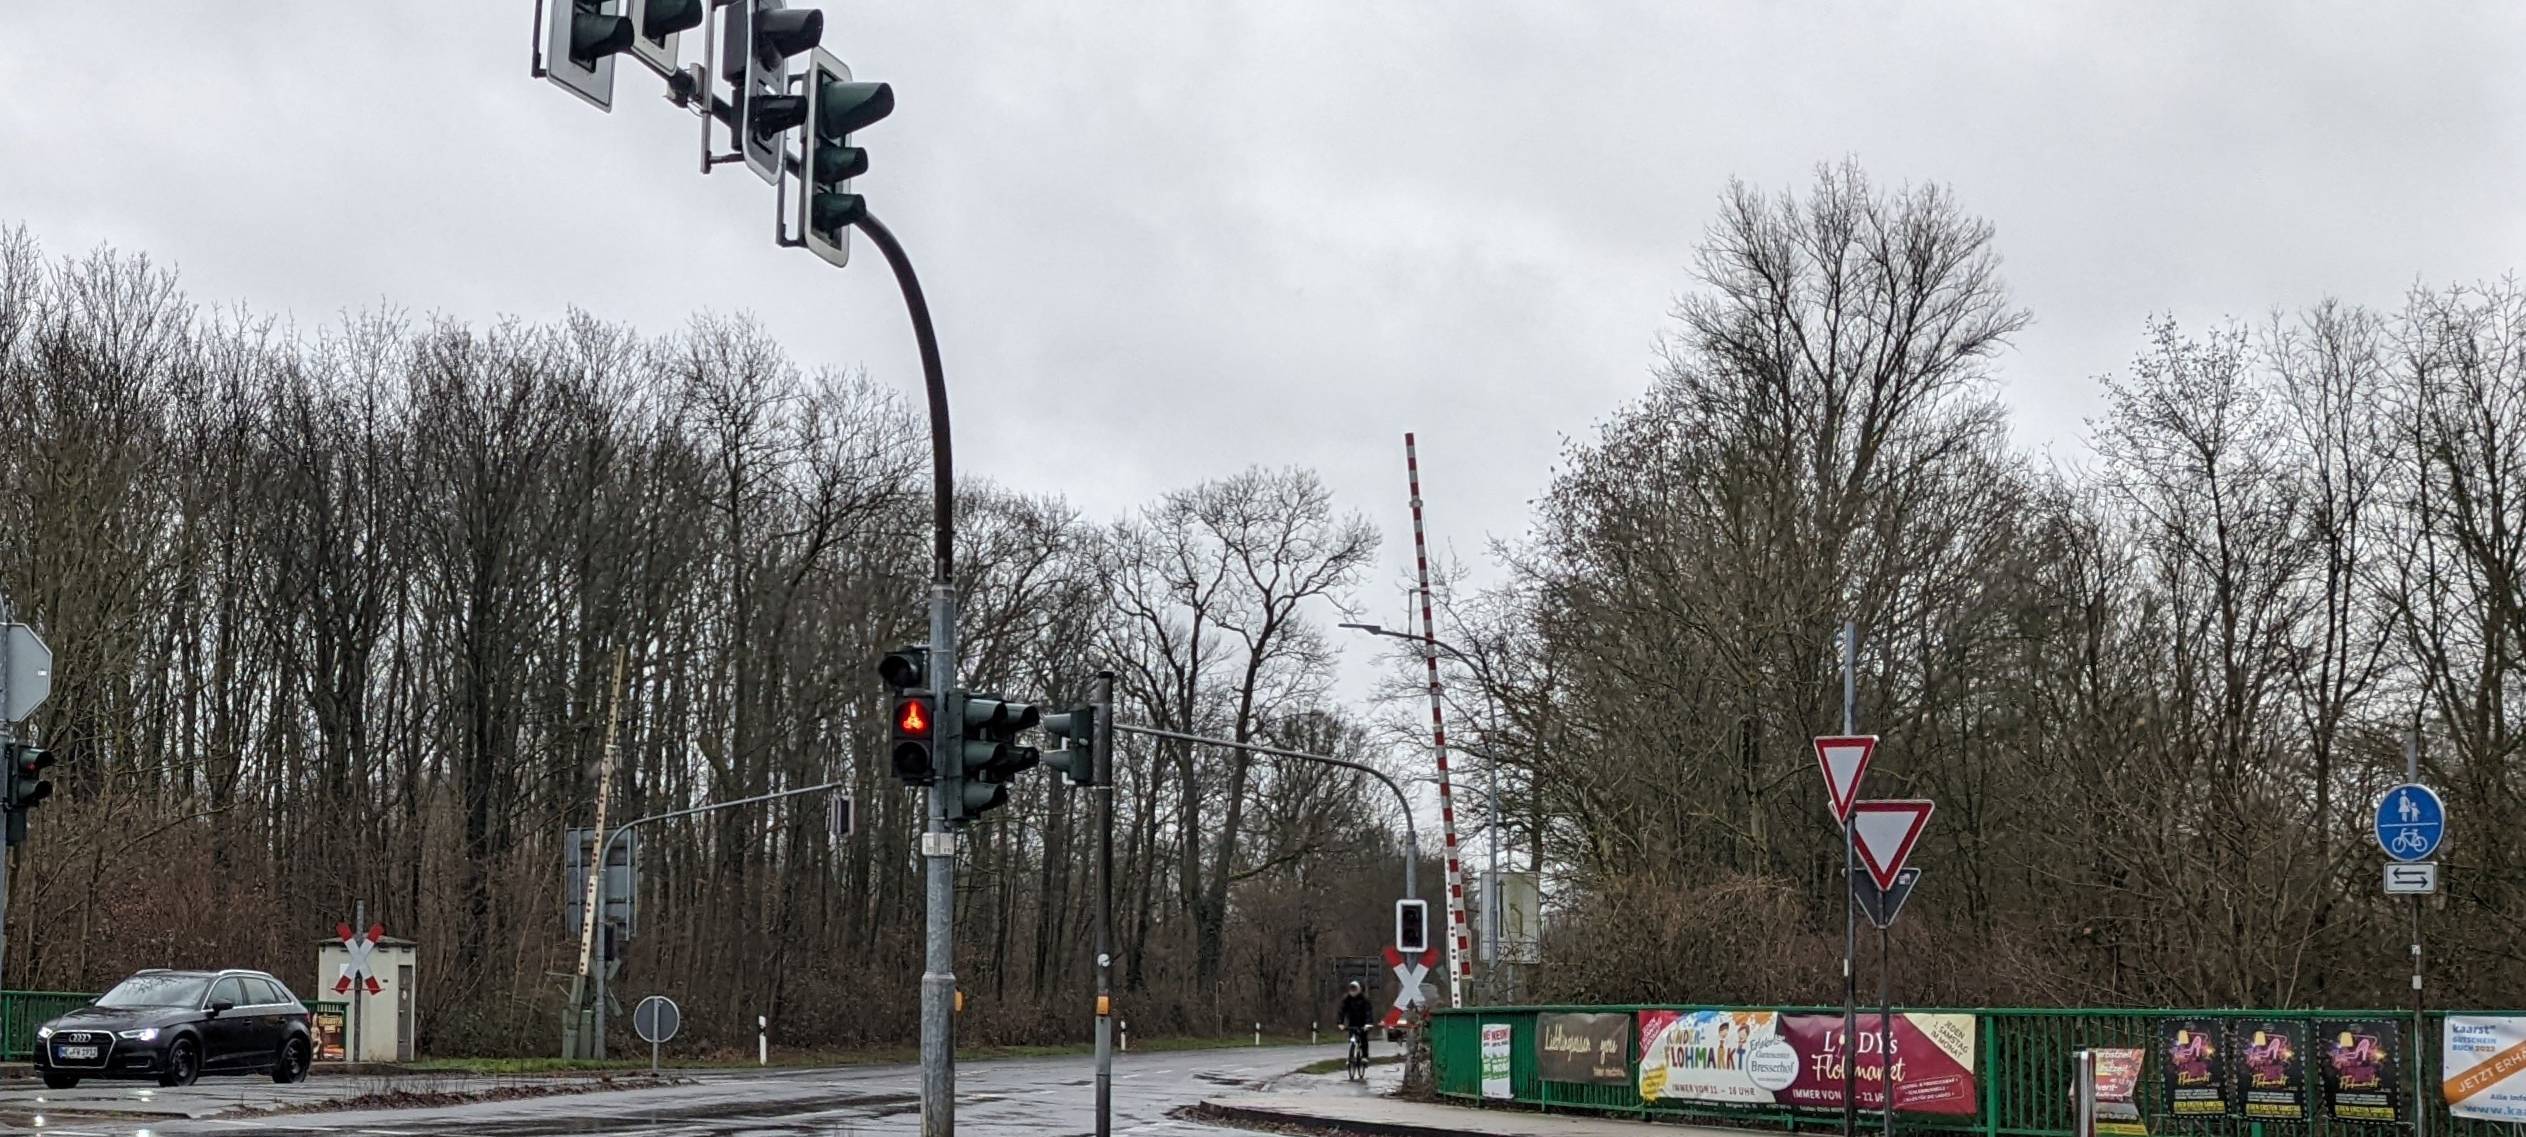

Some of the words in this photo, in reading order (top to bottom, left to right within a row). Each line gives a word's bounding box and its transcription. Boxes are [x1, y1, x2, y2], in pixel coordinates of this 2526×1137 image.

[1938, 1036, 1963, 1058] MONAT
[1939, 1026, 1968, 1053] SAMSTAG
[1664, 1046, 1746, 1071] FLOHMARKT
[1751, 1060, 1795, 1074] Bresserhof
[1672, 1083, 1694, 1094] IMMER
[1738, 1087, 1755, 1096] UHR
[2458, 1067, 2494, 1093] JETZT
[1792, 1088, 1821, 1100] IMMER
[1821, 1089, 1842, 1100] VON
[1861, 1091, 1873, 1102] 22
